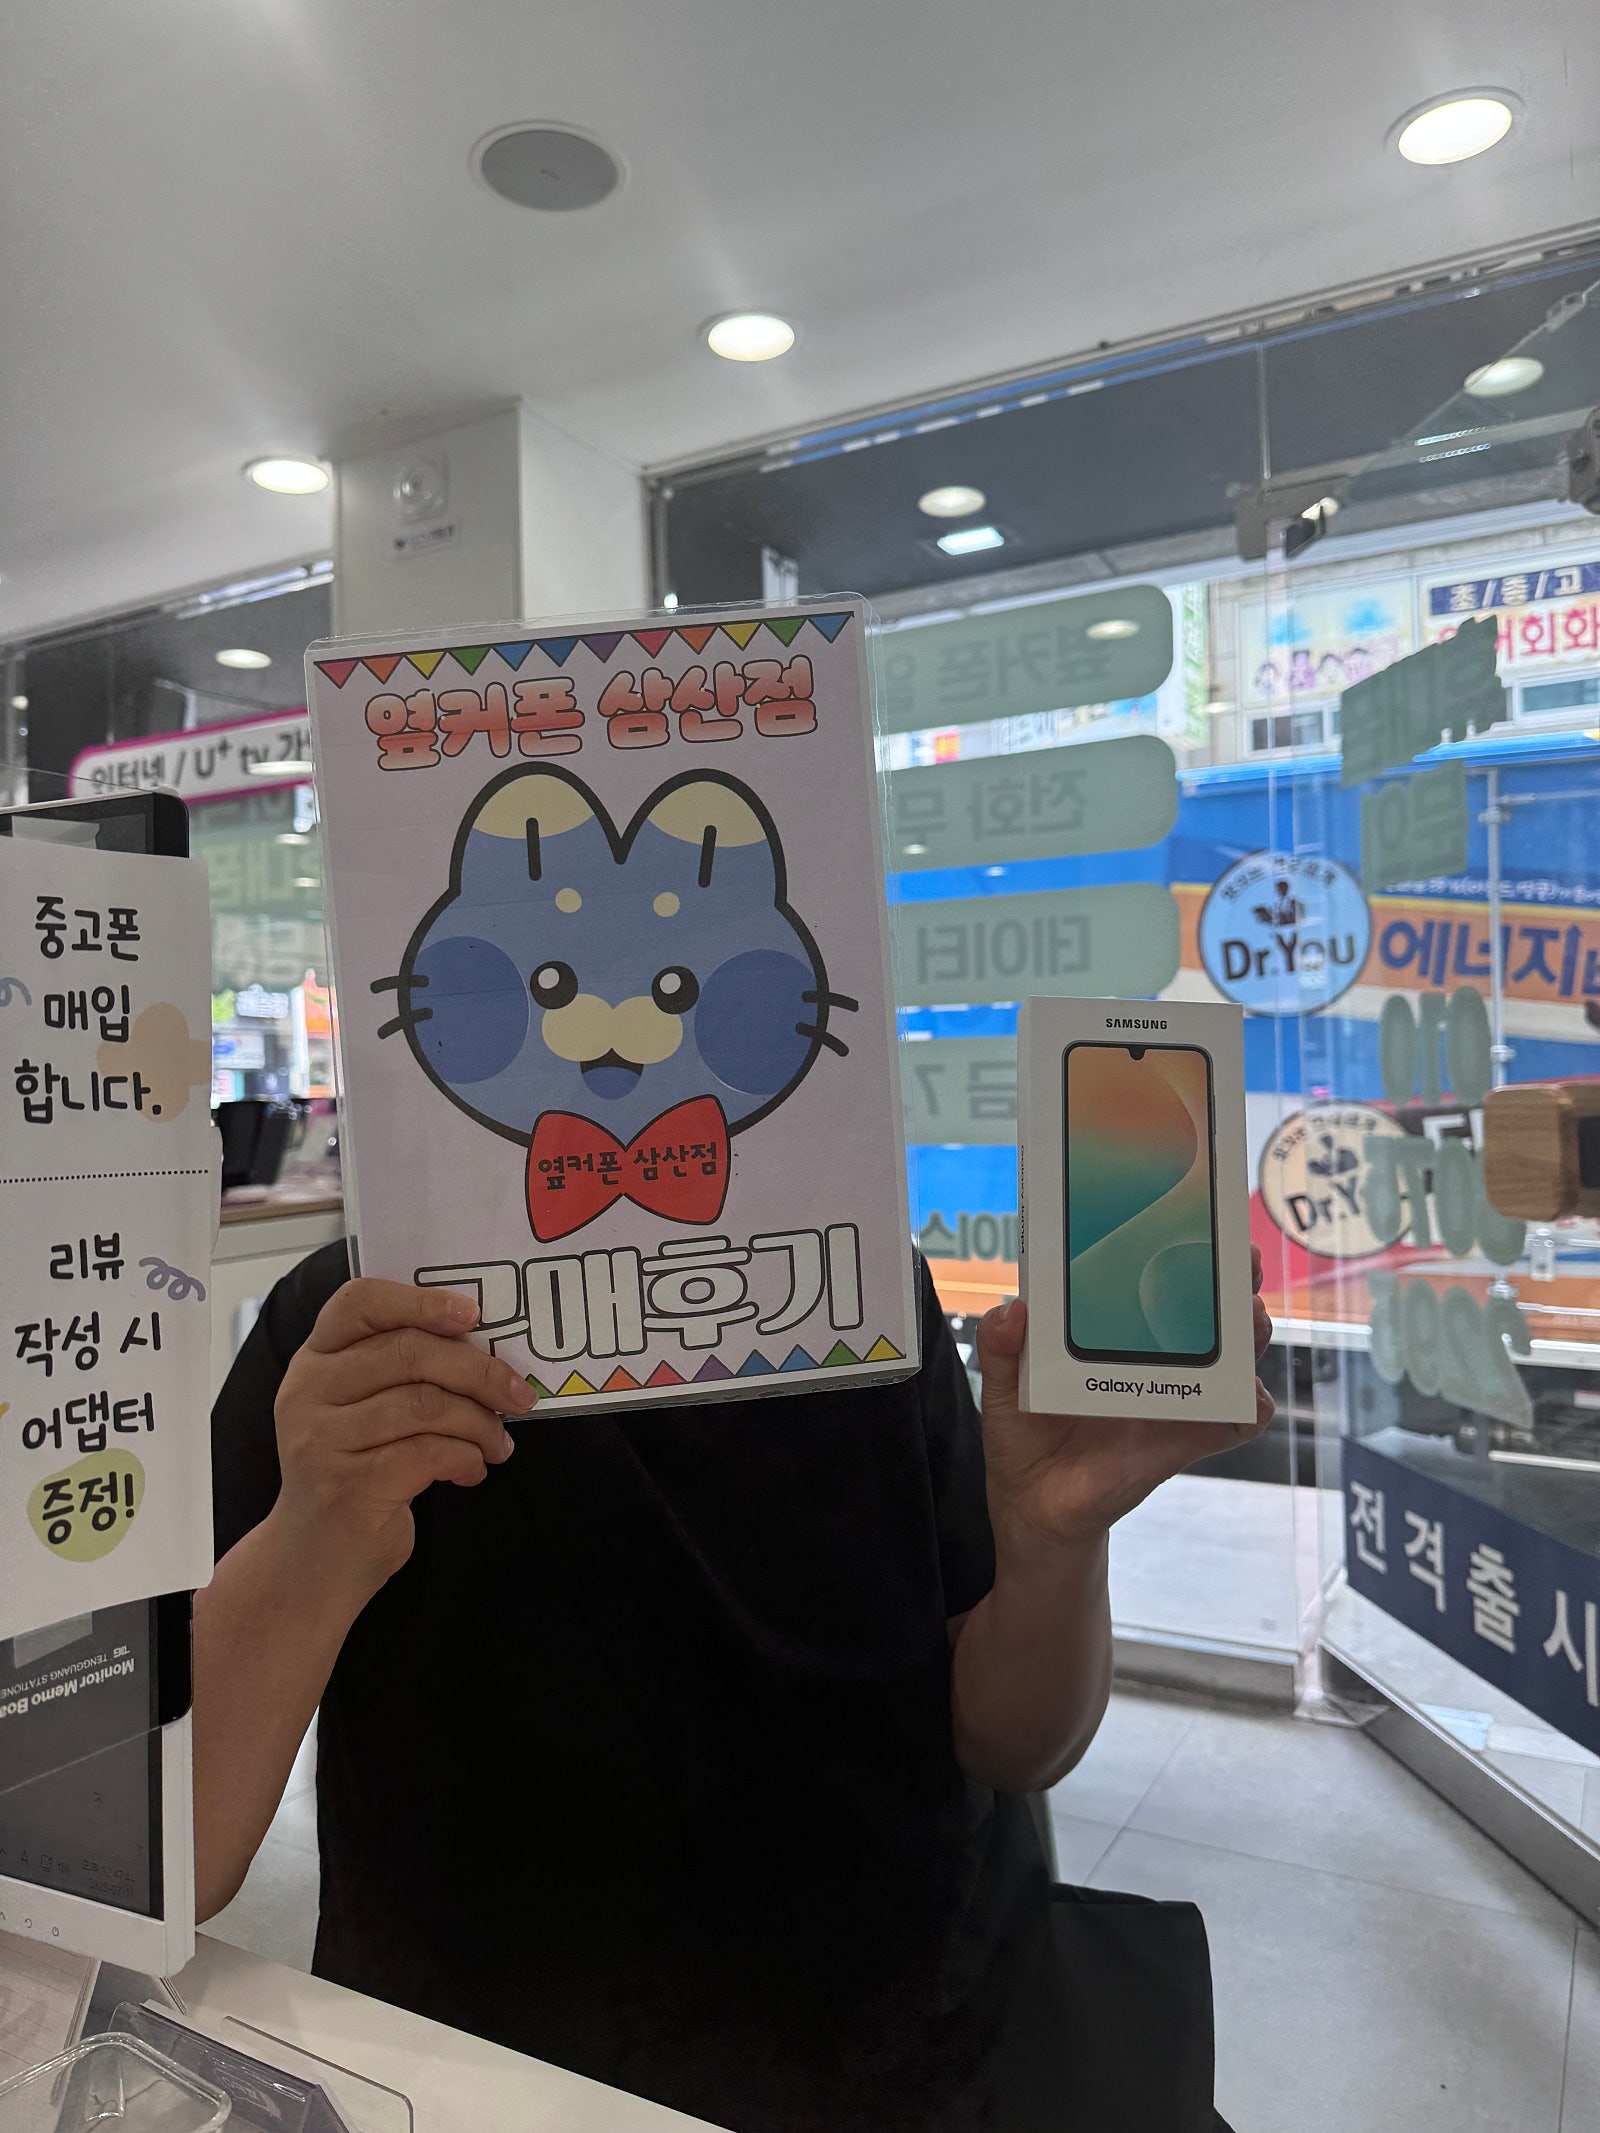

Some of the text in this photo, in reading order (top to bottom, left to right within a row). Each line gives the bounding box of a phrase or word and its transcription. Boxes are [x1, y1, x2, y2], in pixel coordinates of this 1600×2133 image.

[365, 676, 585, 771] 옆커폰
[597, 654, 818, 750] 삼산점
[35, 895, 141, 962] 중고폰
[43, 984, 130, 1042] 매입
[1105, 1017, 1168, 1031] SAMSUNG
[14, 1058, 163, 1125] 합니다.
[538, 1142, 718, 1191] 옆커폰 삼산점
[49, 1232, 124, 1281] 리뷰
[414, 1223, 865, 1363] 구매후기
[15, 1311, 161, 1377] 작성 시
[1085, 1377, 1202, 1399] Galaxy Jump4
[22, 1391, 155, 1453] 어댑터
[42, 1471, 135, 1545] 증정!
[31, 1680, 78, 1705] Memo
[79, 1658, 135, 1688] Monitor
